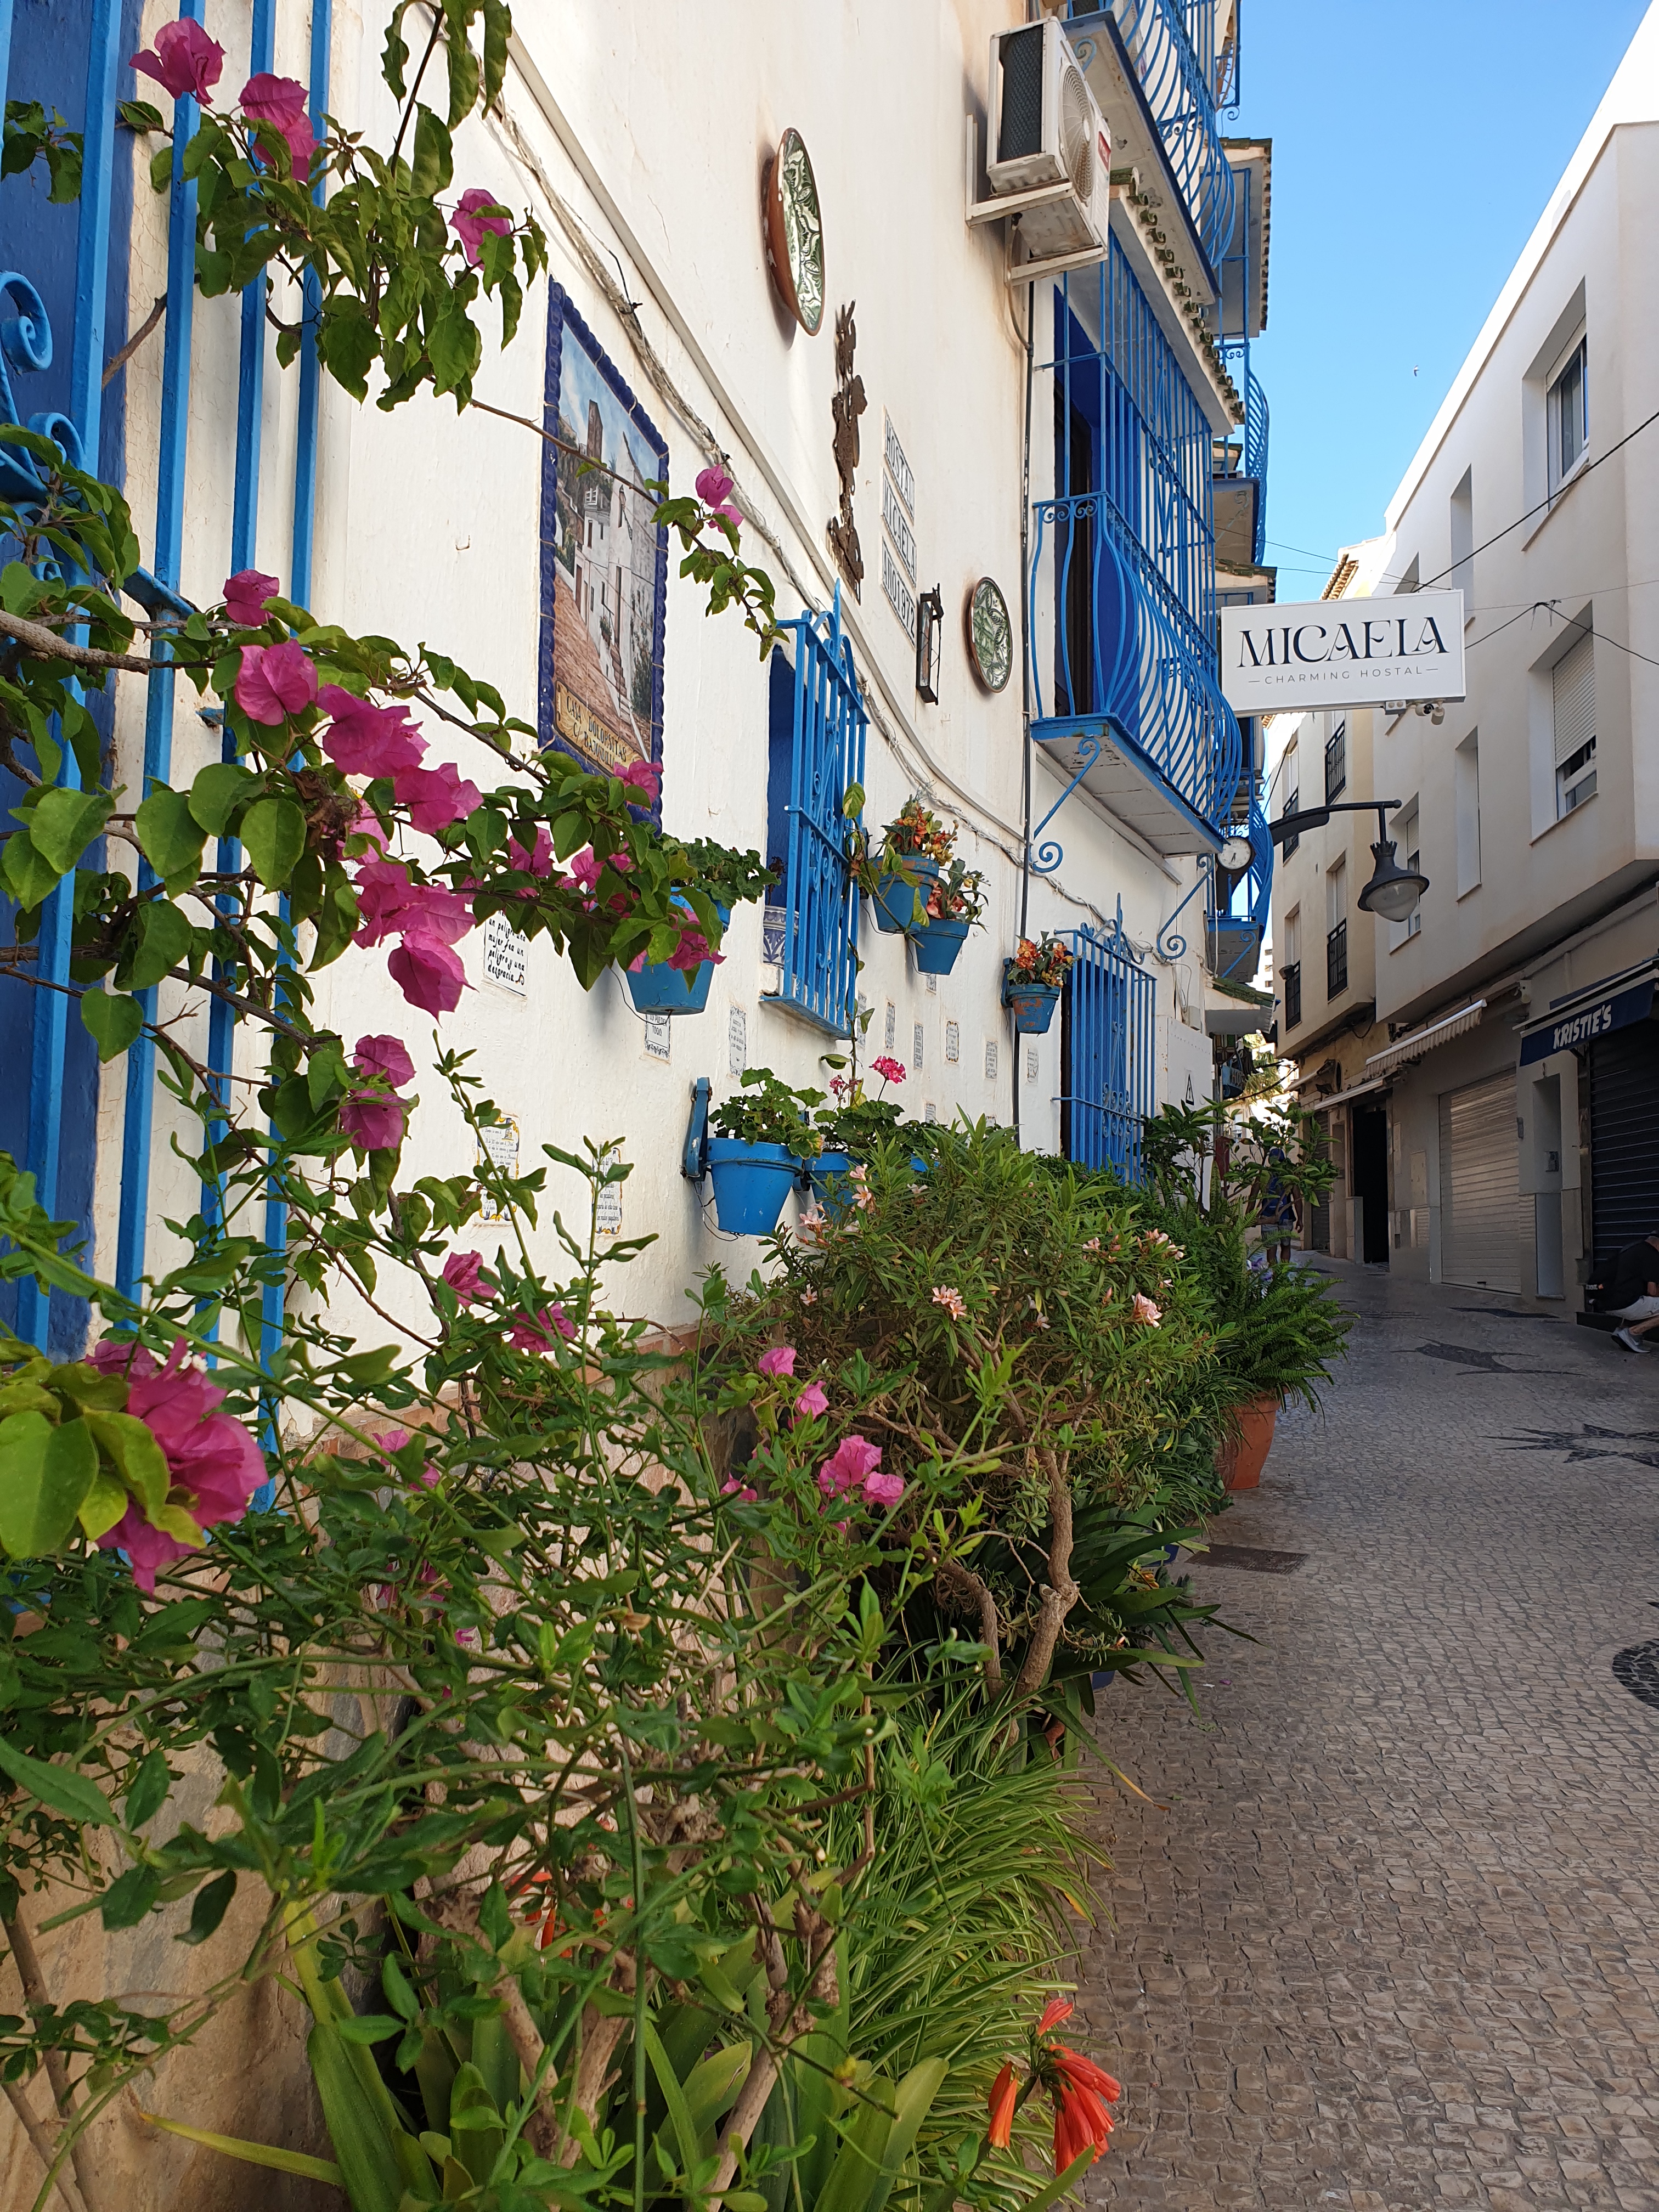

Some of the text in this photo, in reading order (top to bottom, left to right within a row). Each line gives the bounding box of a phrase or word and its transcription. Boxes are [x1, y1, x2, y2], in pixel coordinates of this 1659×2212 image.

[886, 420, 913, 512] HOSTAL
[884, 479, 915, 578] MICAELA
[1237, 617, 1450, 668] MICAELA
[1265, 665, 1423, 685] CHARMING HOSTAL
[567, 696, 582, 724] CASA
[573, 721, 581, 743] C/
[489, 918, 495, 927] un
[488, 934, 524, 957] mujer fea un
[487, 947, 525, 972] peligro y una
[488, 960, 515, 982] desgracia
[1553, 1005, 1612, 1050] KRISTIE'S
